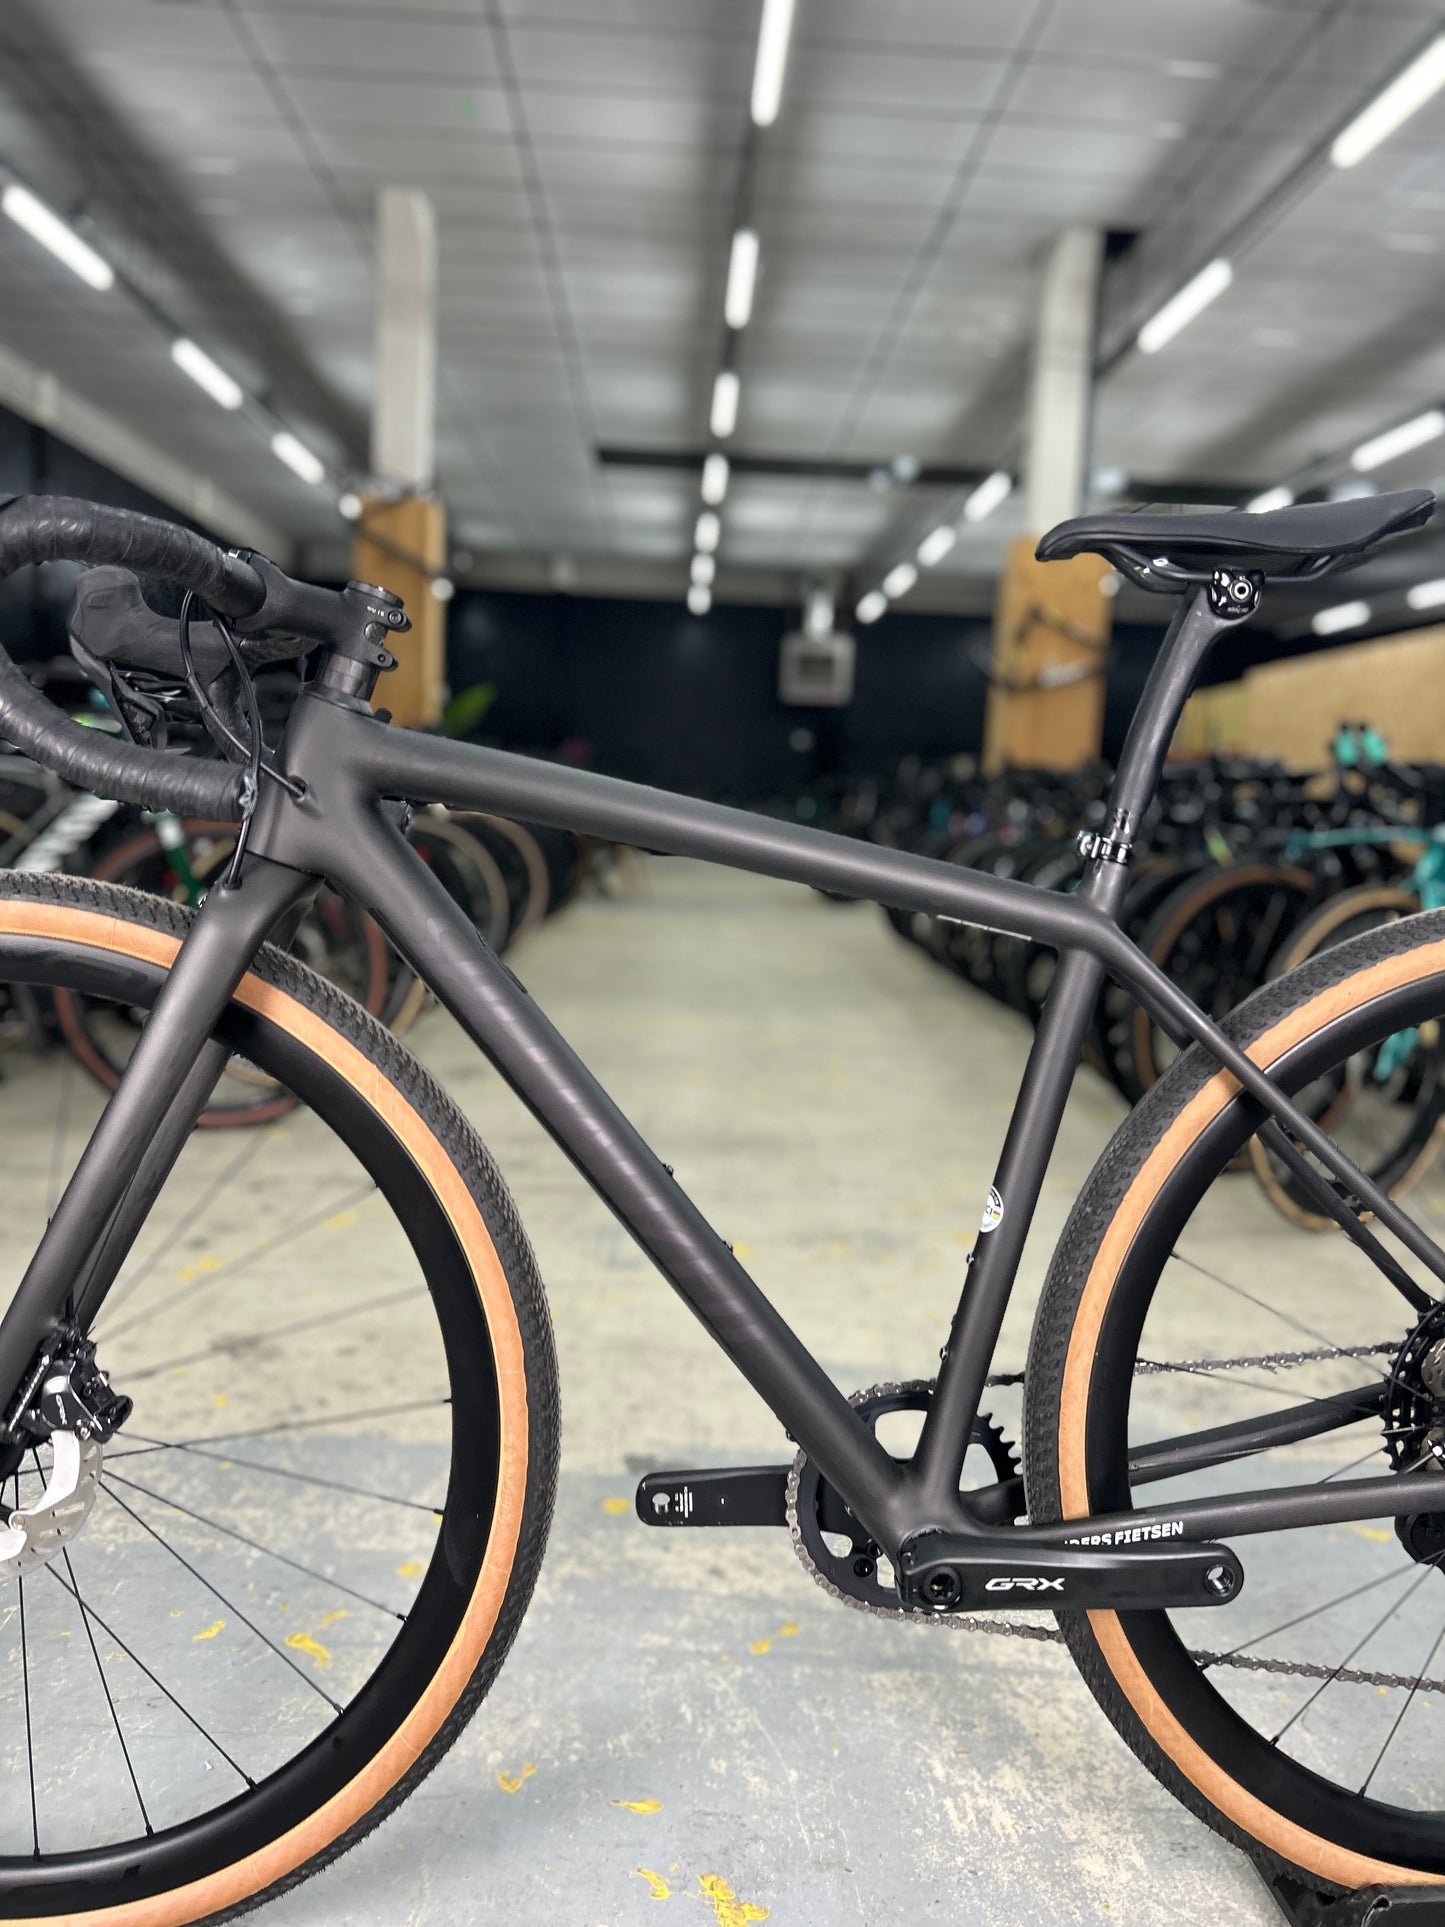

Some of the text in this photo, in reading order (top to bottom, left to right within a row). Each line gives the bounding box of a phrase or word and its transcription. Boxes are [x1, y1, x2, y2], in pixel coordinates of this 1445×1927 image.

[1064, 1521, 1184, 1546] ERS FIETSEN
[984, 1577, 1066, 1592] GRX
